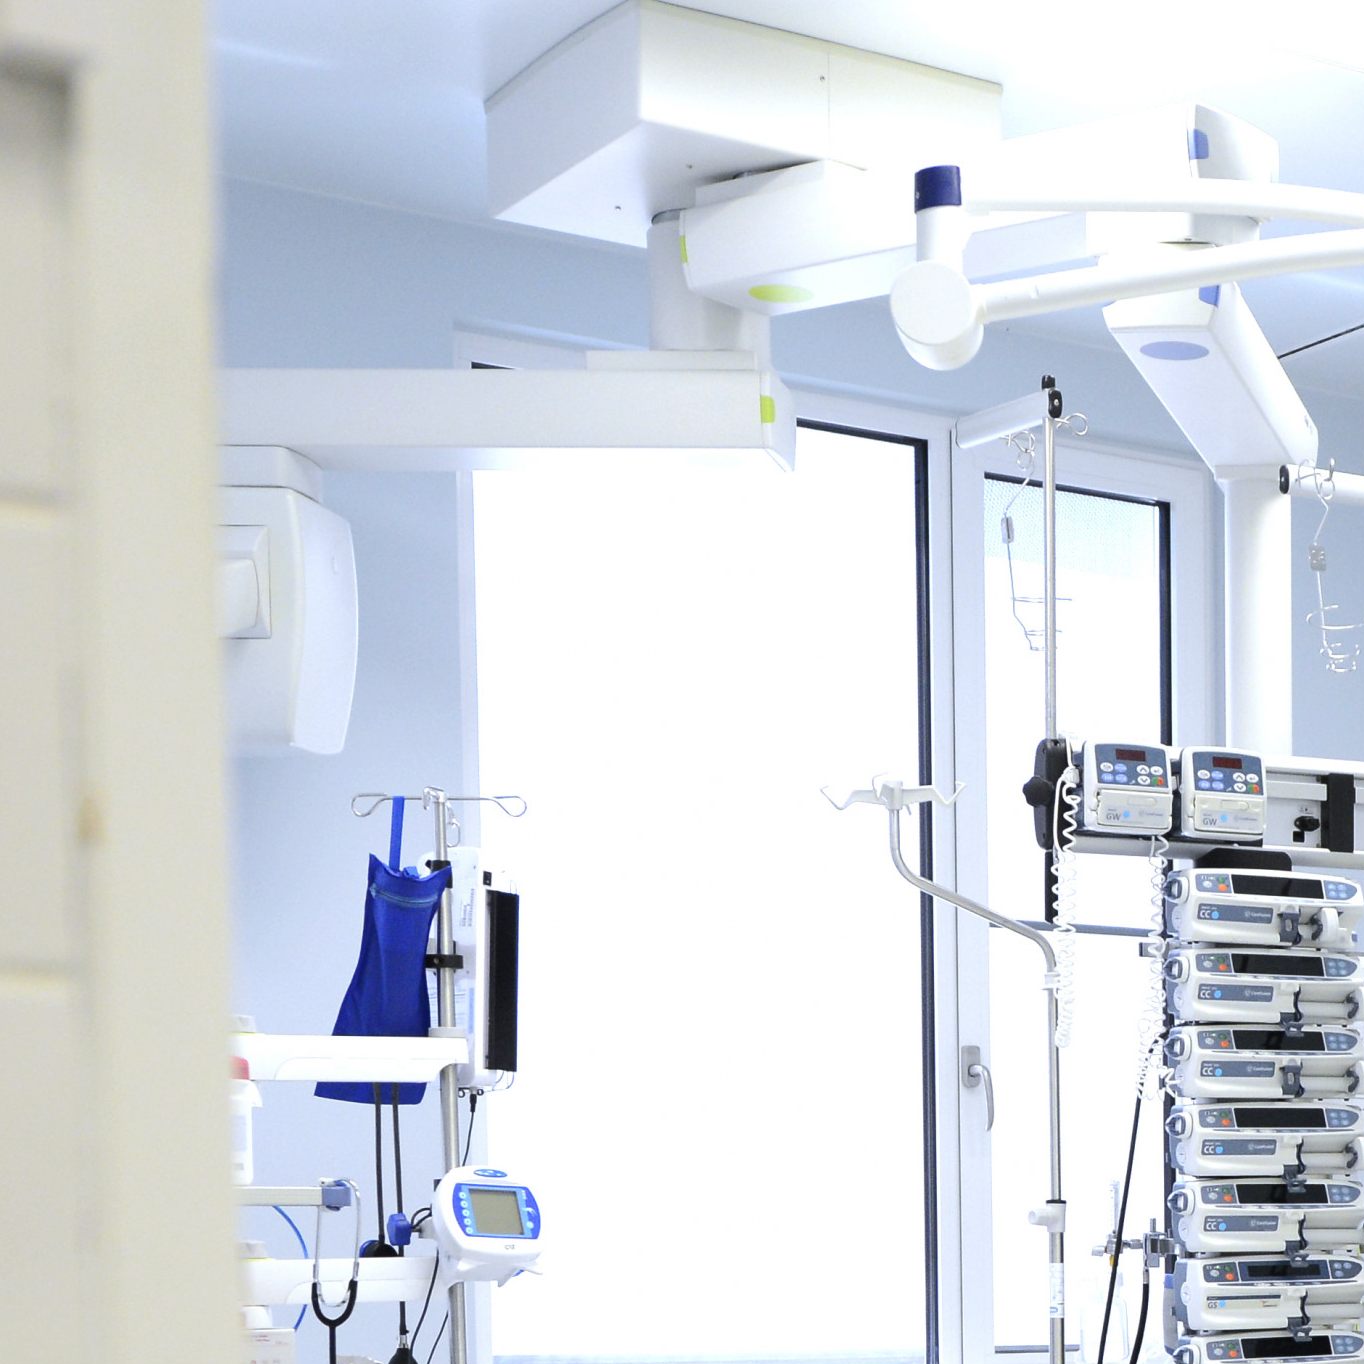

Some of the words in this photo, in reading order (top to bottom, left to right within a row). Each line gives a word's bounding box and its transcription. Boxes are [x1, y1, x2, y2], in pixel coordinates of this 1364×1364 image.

[1106, 813, 1121, 821] GW
[1202, 817, 1217, 826] GW
[1200, 910, 1211, 918] CC
[1200, 990, 1211, 998] CC
[1202, 1067, 1213, 1075] CC
[1203, 1145, 1214, 1153] CC
[1206, 1222, 1217, 1230] CC
[1208, 1301, 1217, 1309] GS
